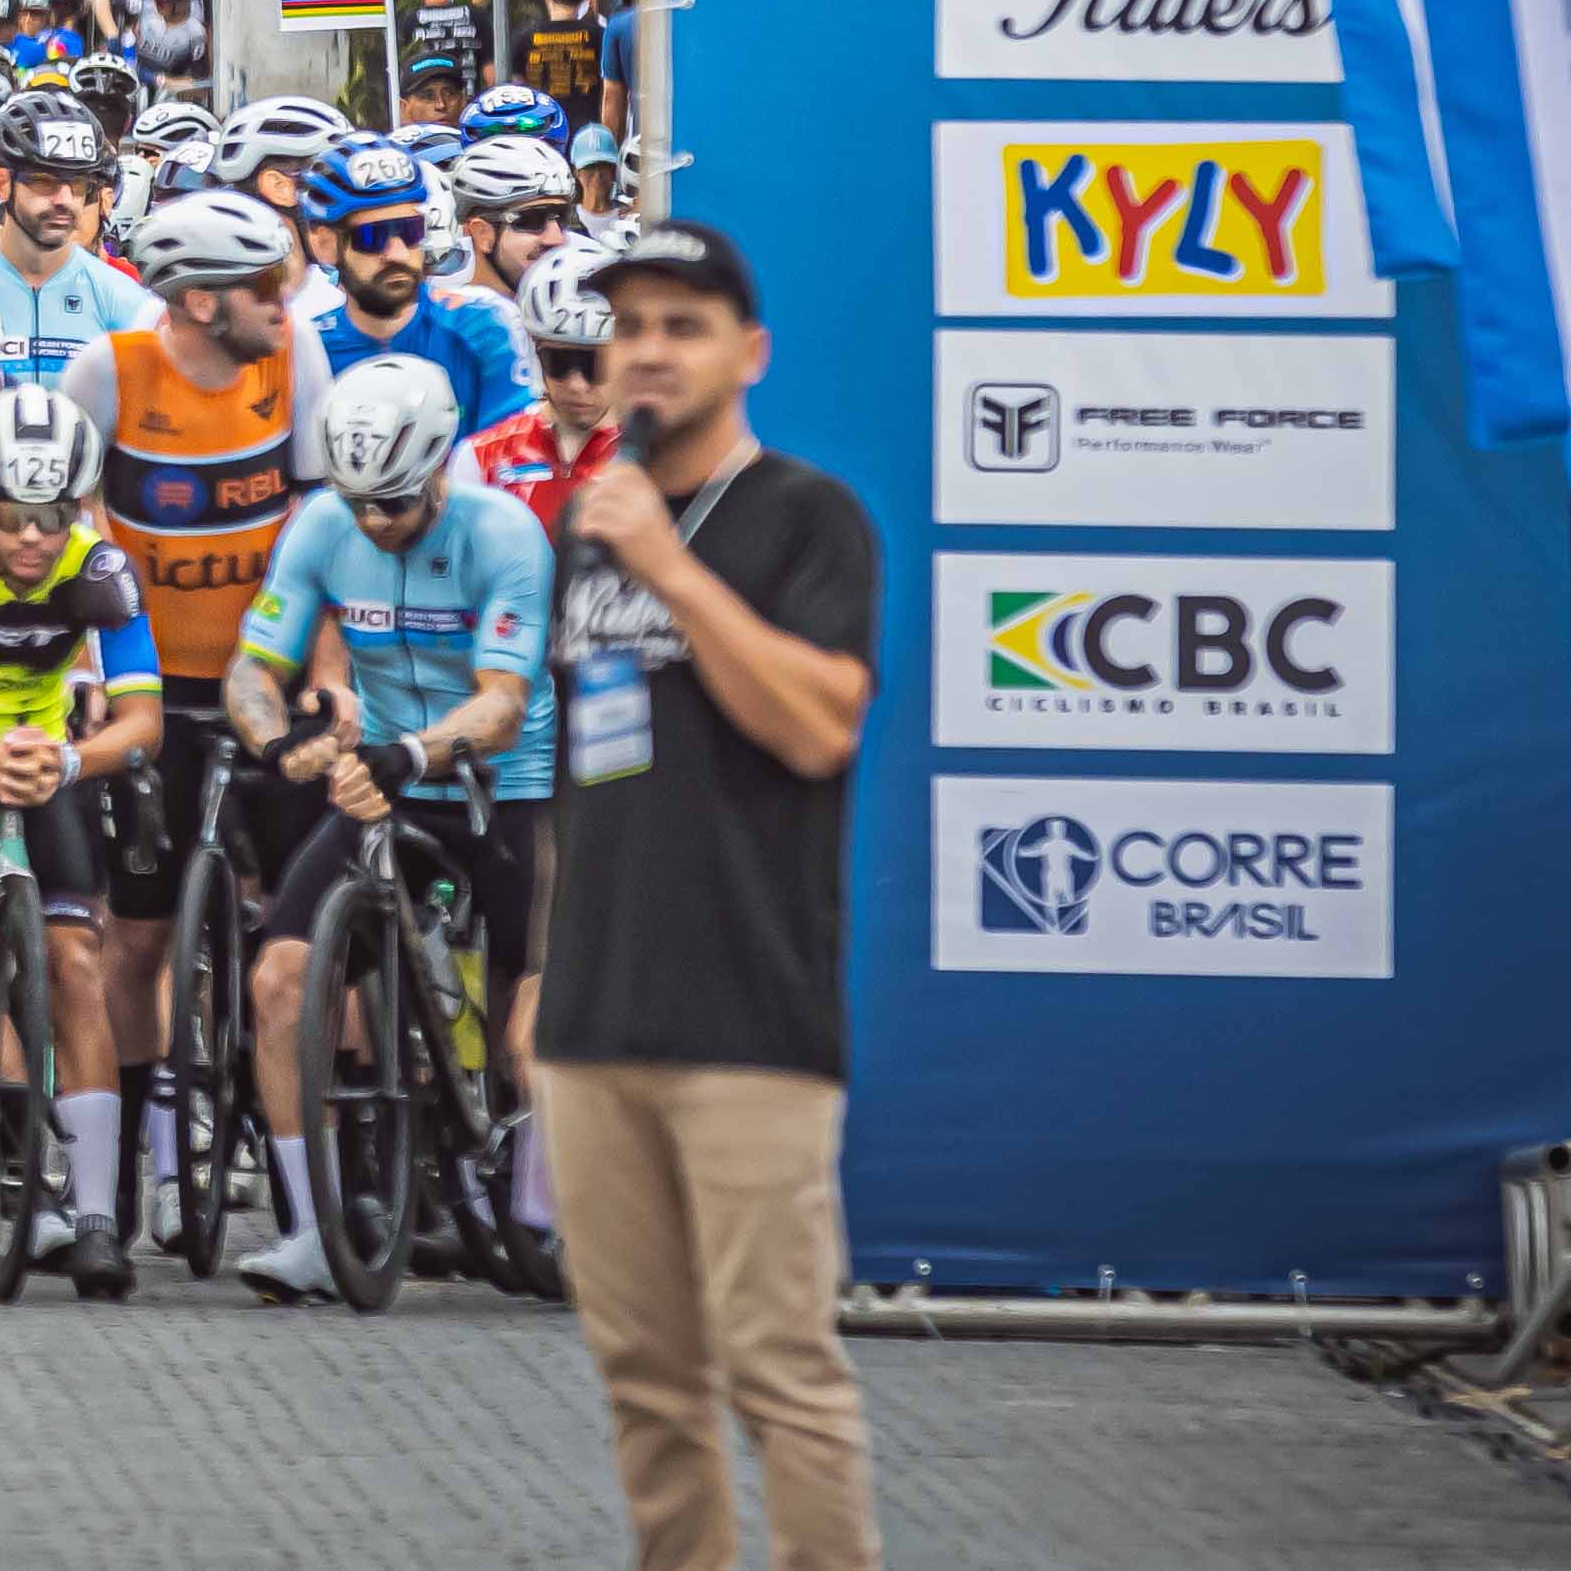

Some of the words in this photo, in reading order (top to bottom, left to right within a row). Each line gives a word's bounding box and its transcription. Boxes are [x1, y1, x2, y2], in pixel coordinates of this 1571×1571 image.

[45, 133, 96, 159] 216
[1016, 153, 1314, 281] KYLY
[553, 307, 611, 338] 217
[1073, 406, 1200, 429] FREE
[1210, 408, 1370, 432] FORCE
[7, 457, 66, 489] 125
[1082, 594, 1342, 695] CBC
[984, 695, 1176, 717] CICLISMO
[1202, 699, 1346, 719] BRASIL
[1110, 830, 1363, 890] CORRE
[1150, 900, 1320, 942] BRASIL
